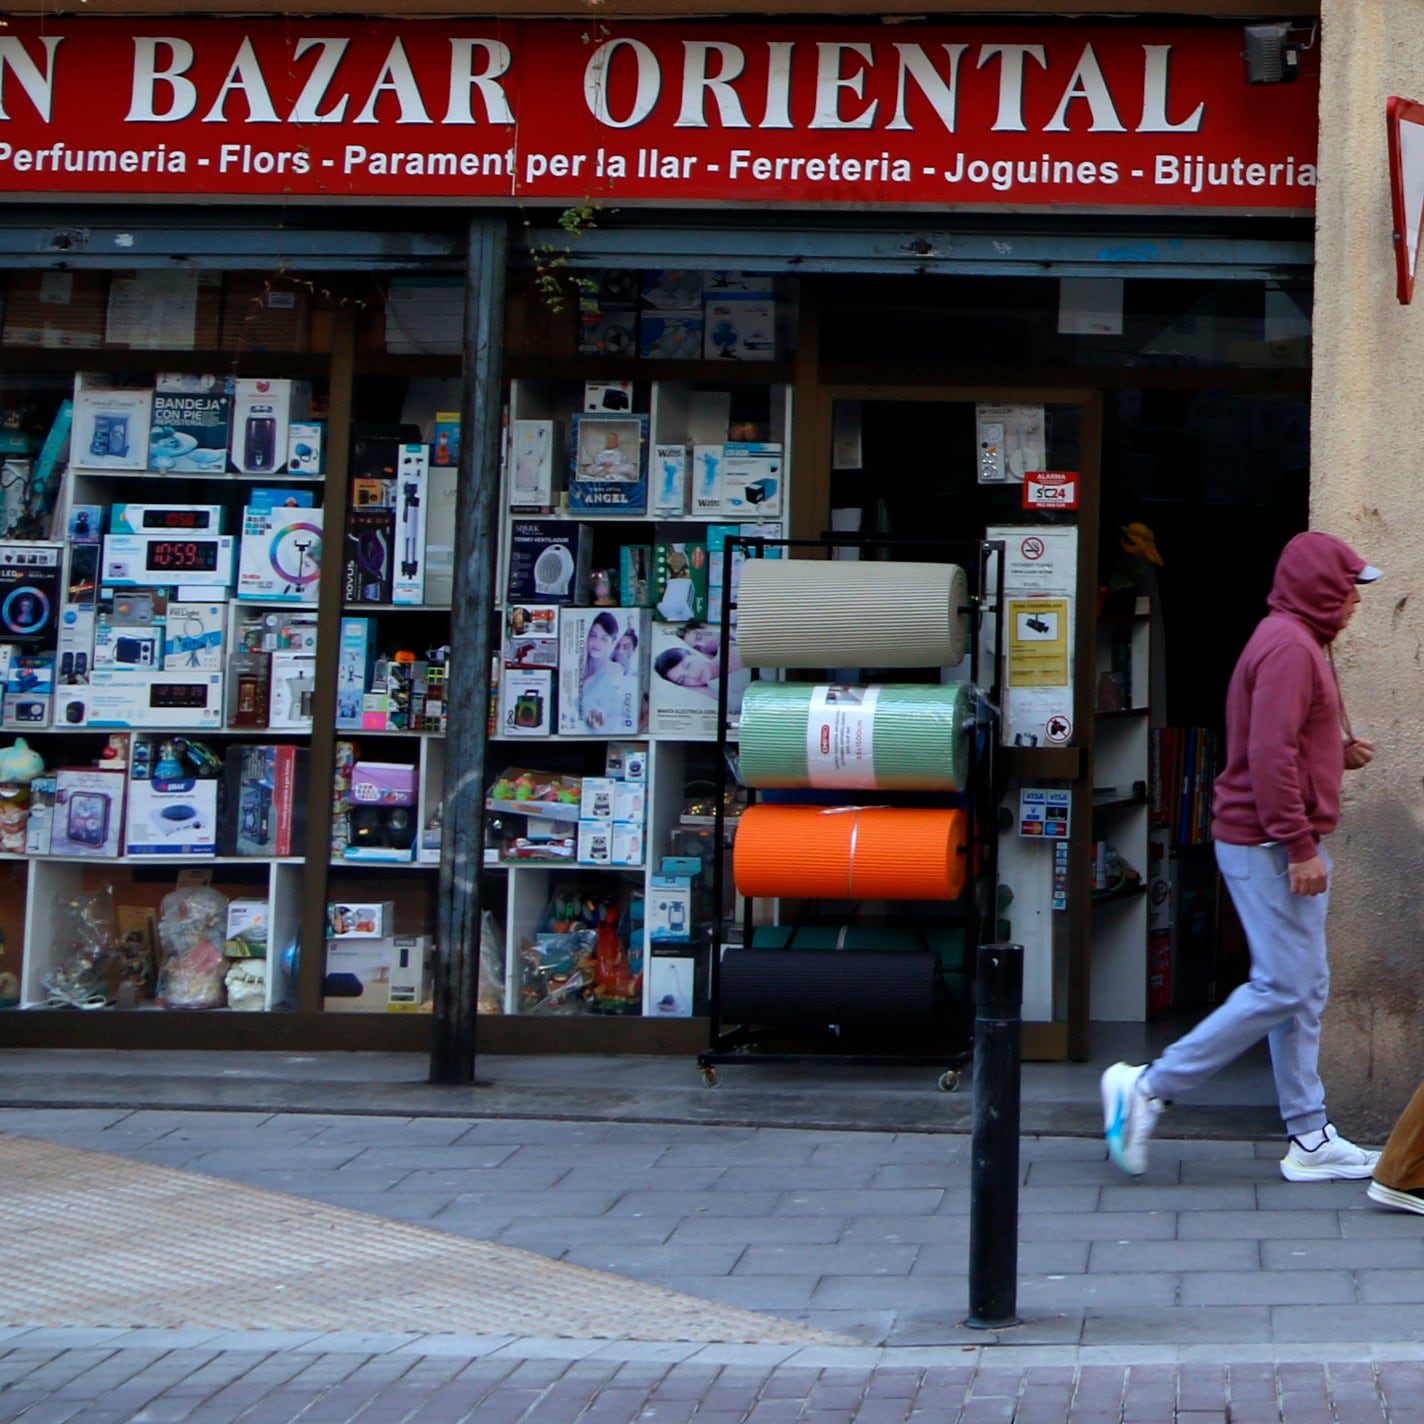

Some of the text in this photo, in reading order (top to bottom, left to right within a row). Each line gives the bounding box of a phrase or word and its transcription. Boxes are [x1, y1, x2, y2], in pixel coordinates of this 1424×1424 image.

[124, 35, 517, 125] BAZAR
[584, 37, 1205, 134] ORIENTAL
[218, 143, 311, 175] Flors
[343, 145, 515, 177] Parament
[526, 153, 587, 184] per
[596, 147, 627, 178] la
[637, 148, 698, 178] llar
[729, 150, 911, 183] Ferreteria
[944, 153, 1119, 191] Joguines
[1153, 154, 1318, 193] Bijuteria
[155, 397, 220, 411] BANDEJA
[155, 409, 202, 421] CON PIE
